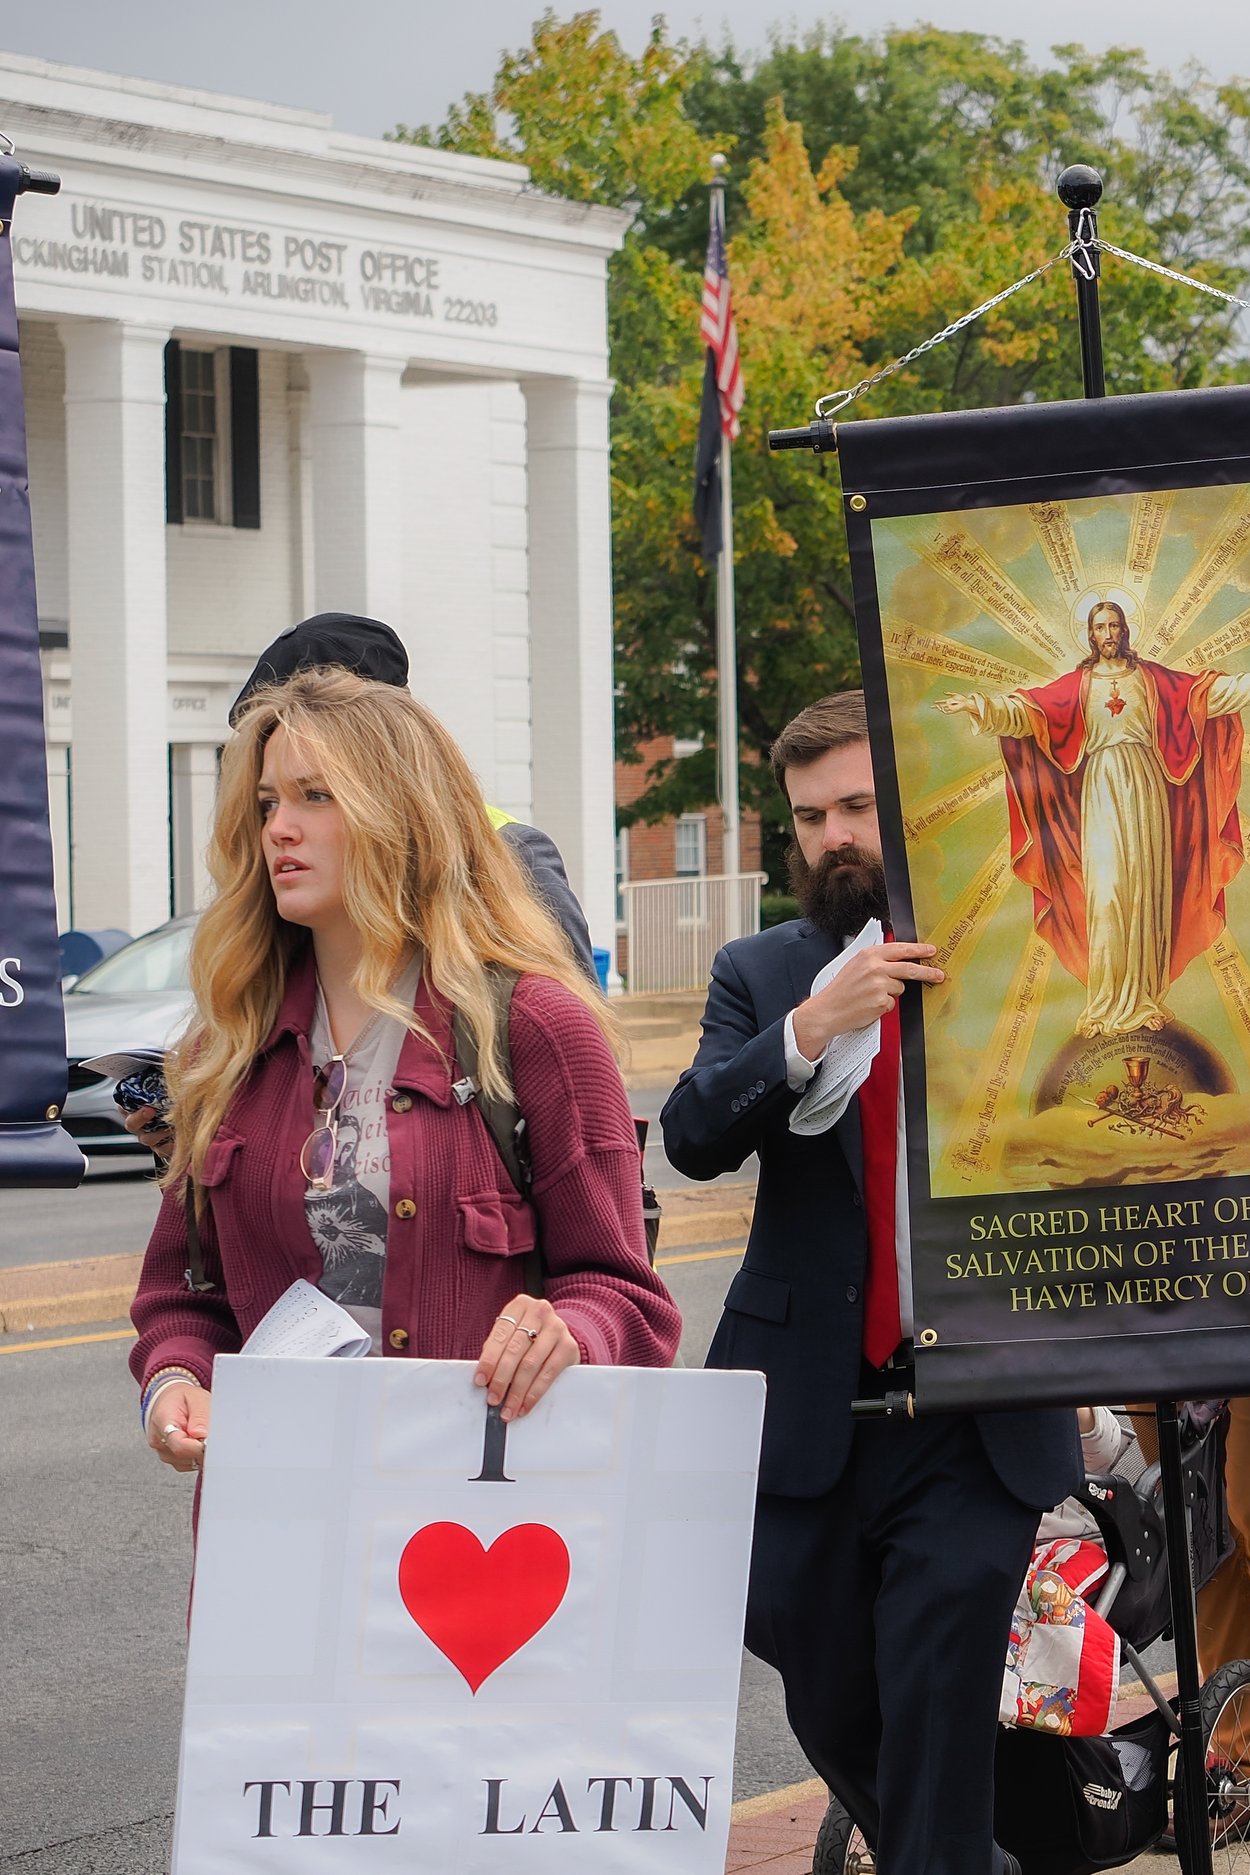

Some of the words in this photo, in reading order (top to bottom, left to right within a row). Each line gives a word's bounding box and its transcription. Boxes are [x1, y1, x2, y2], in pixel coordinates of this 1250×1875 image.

[70, 202, 166, 250] UNITED
[179, 220, 271, 265] STATES
[284, 235, 348, 275] POST
[360, 249, 439, 290] OFFICE
[13, 236, 129, 279] CKINGHAM
[142, 254, 230, 295] STATION,
[242, 270, 350, 311] ARLINGTON,
[360, 284, 434, 318] VIRGINIA
[444, 296, 498, 327] 22203
[968, 578, 988, 596] their
[985, 596, 1030, 634] undertakings.
[1002, 592, 1034, 622] abundant
[1032, 620, 1066, 658] benedictions
[1032, 946, 1046, 958] life.
[1020, 984, 1034, 1002] their
[1026, 966, 1038, 983] state
[1006, 1014, 1026, 1048] necessary
[998, 1050, 1012, 1075] graces
[969, 1208, 1089, 1242] SACRED
[1099, 1201, 1205, 1232] HEART
[946, 1242, 1124, 1280] SALVATION
[1133, 1239, 1176, 1269] OF
[1184, 1233, 1249, 1264] THE
[1009, 1283, 1097, 1312] HAVE
[1105, 1273, 1214, 1306] MERCY
[467, 1402, 517, 1483] I
[243, 1778, 401, 1838] THE
[478, 1775, 715, 1836] LATIN
